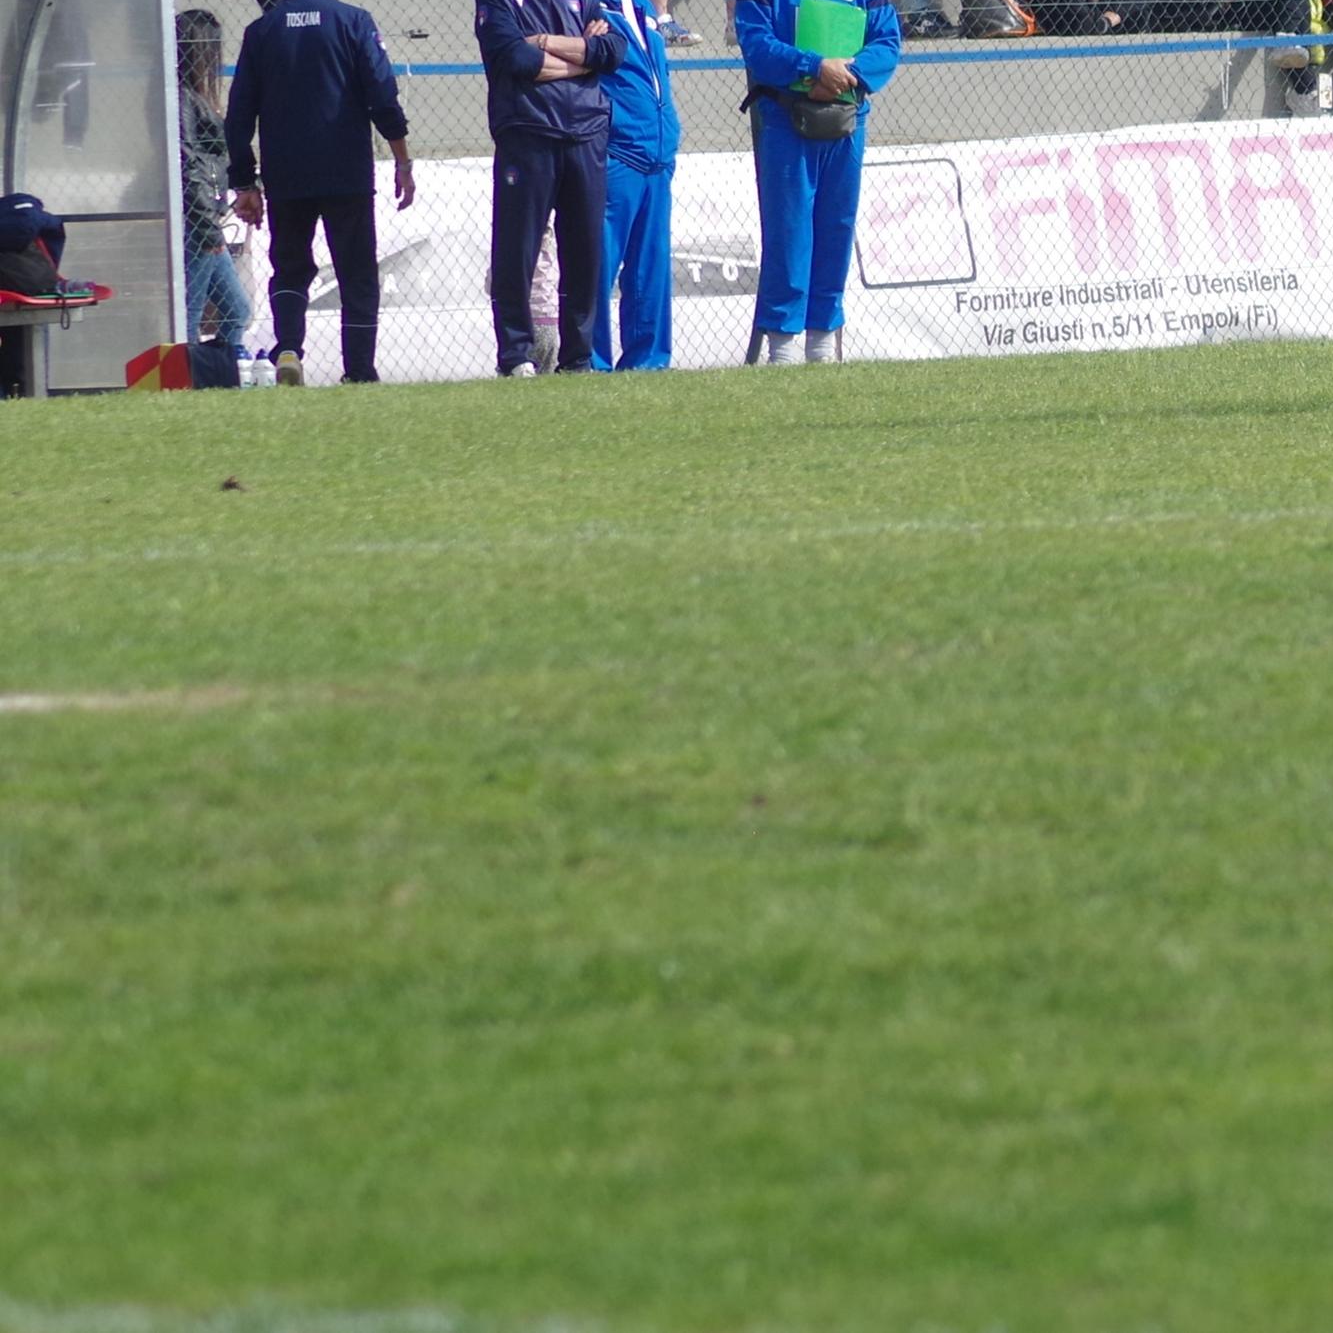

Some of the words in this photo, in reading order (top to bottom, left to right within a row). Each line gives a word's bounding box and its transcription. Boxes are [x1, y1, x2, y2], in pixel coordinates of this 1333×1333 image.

[286, 11, 320, 28] TOSCANA
[954, 287, 1053, 315] Forniture
[1060, 278, 1164, 306] Industriali
[1185, 269, 1299, 297] Utensileria
[984, 324, 1015, 347] Via
[1022, 318, 1085, 344] Giusti
[1164, 307, 1239, 335] Empoli
[1246, 304, 1279, 331] (Fi)
